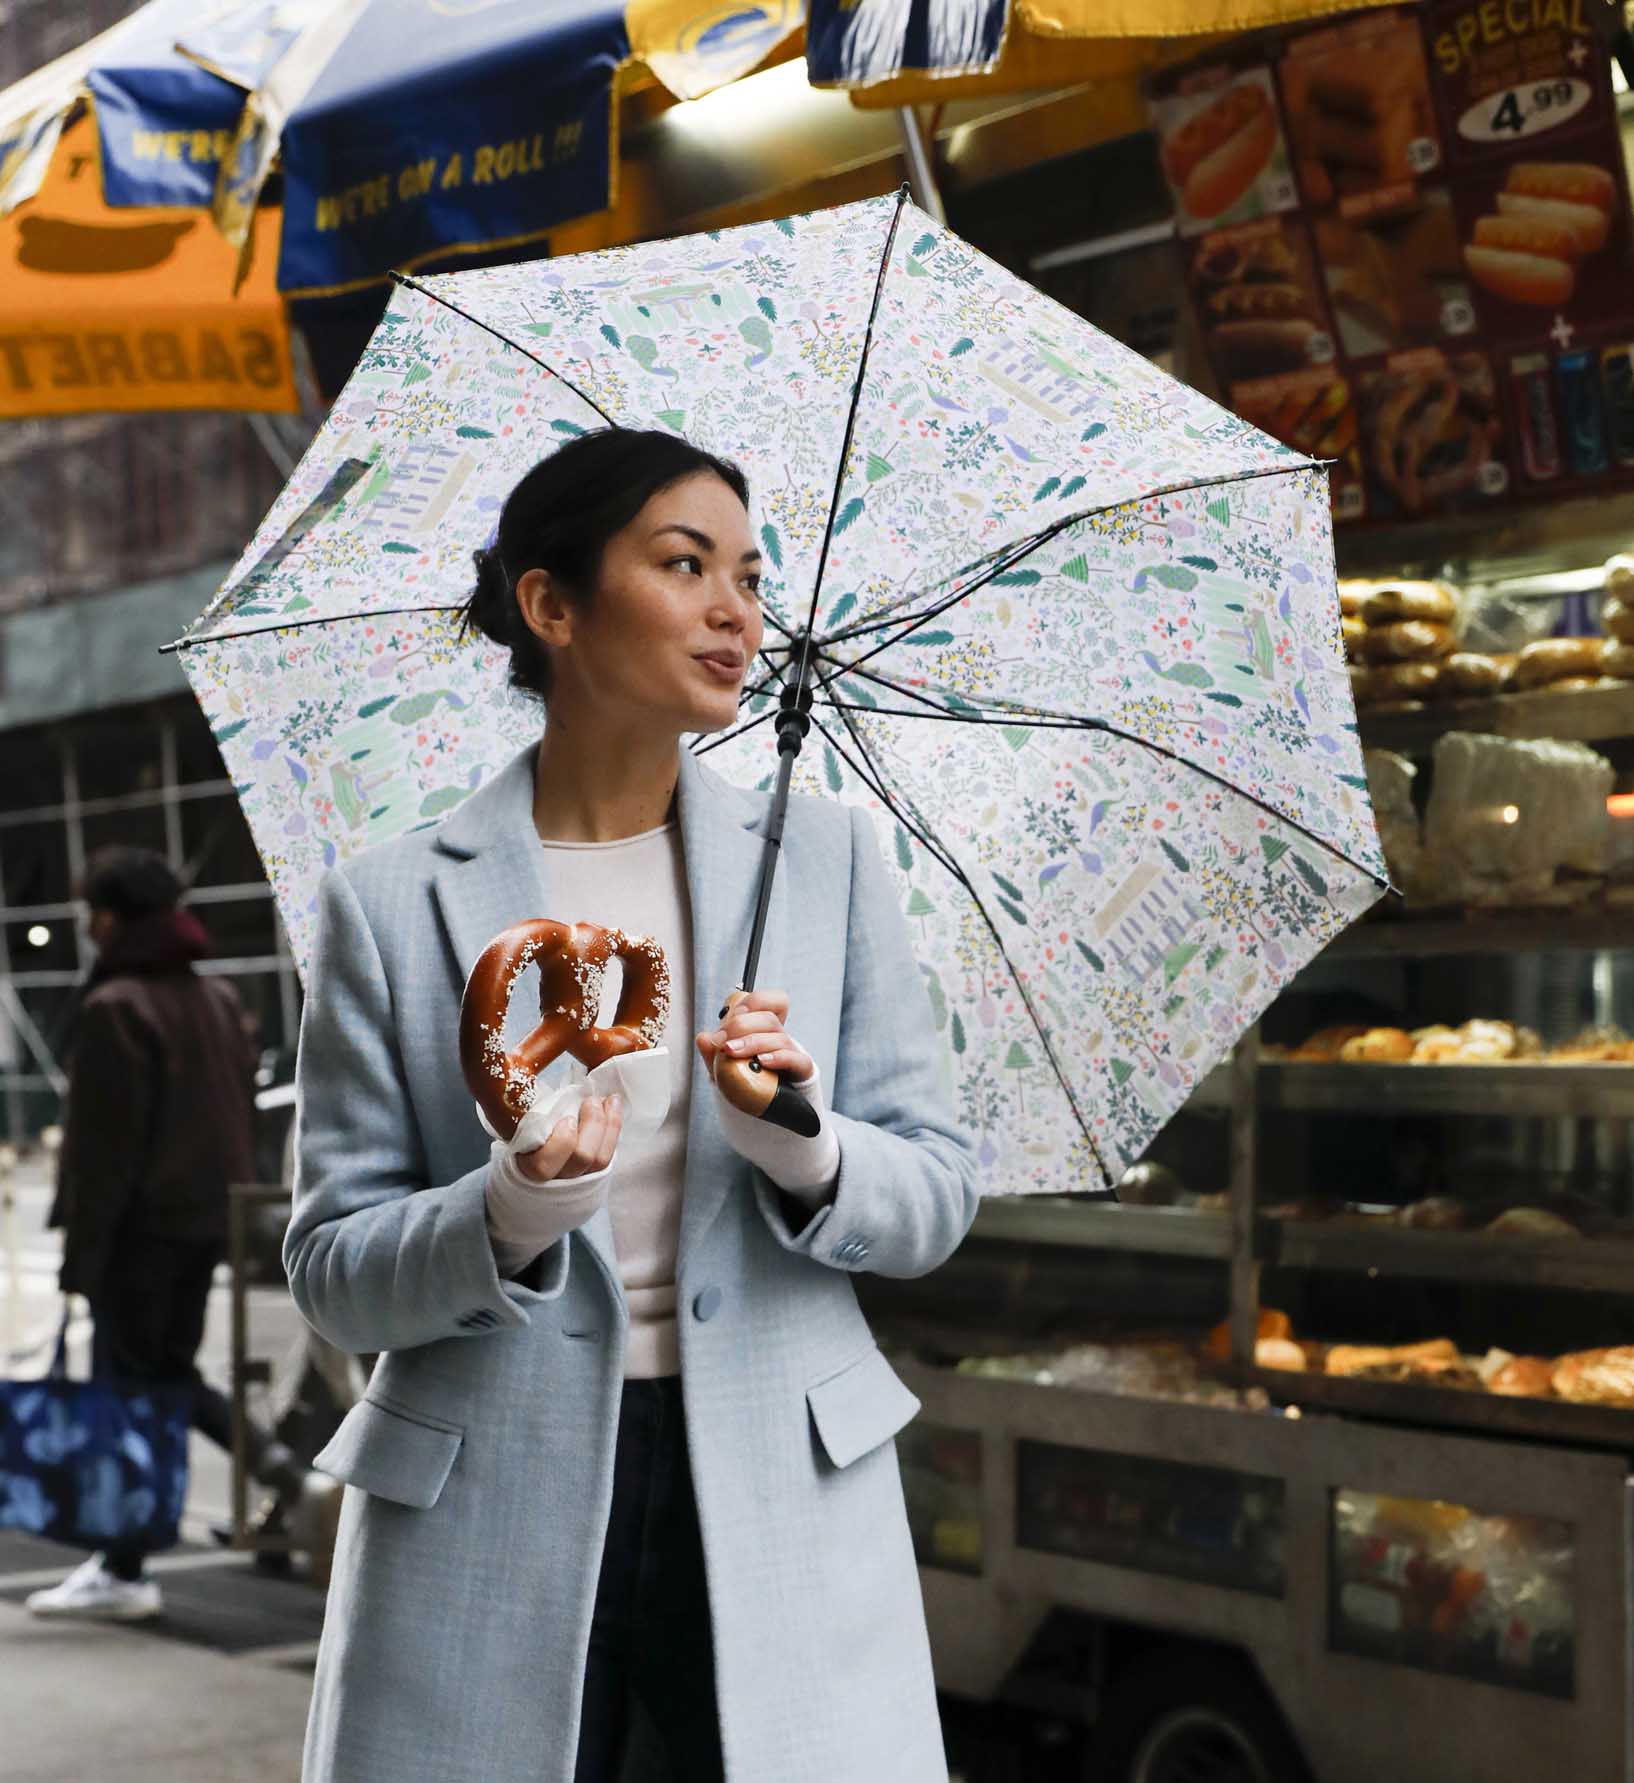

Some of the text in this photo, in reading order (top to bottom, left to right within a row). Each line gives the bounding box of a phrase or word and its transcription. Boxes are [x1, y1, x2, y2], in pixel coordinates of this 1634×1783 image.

[1434, 0, 1593, 73] SPECIAL
[1491, 82, 1573, 132] 4.99
[315, 174, 389, 232] WE'RE
[398, 157, 437, 200] ON
[440, 152, 463, 190] A
[472, 133, 544, 186] ROLL
